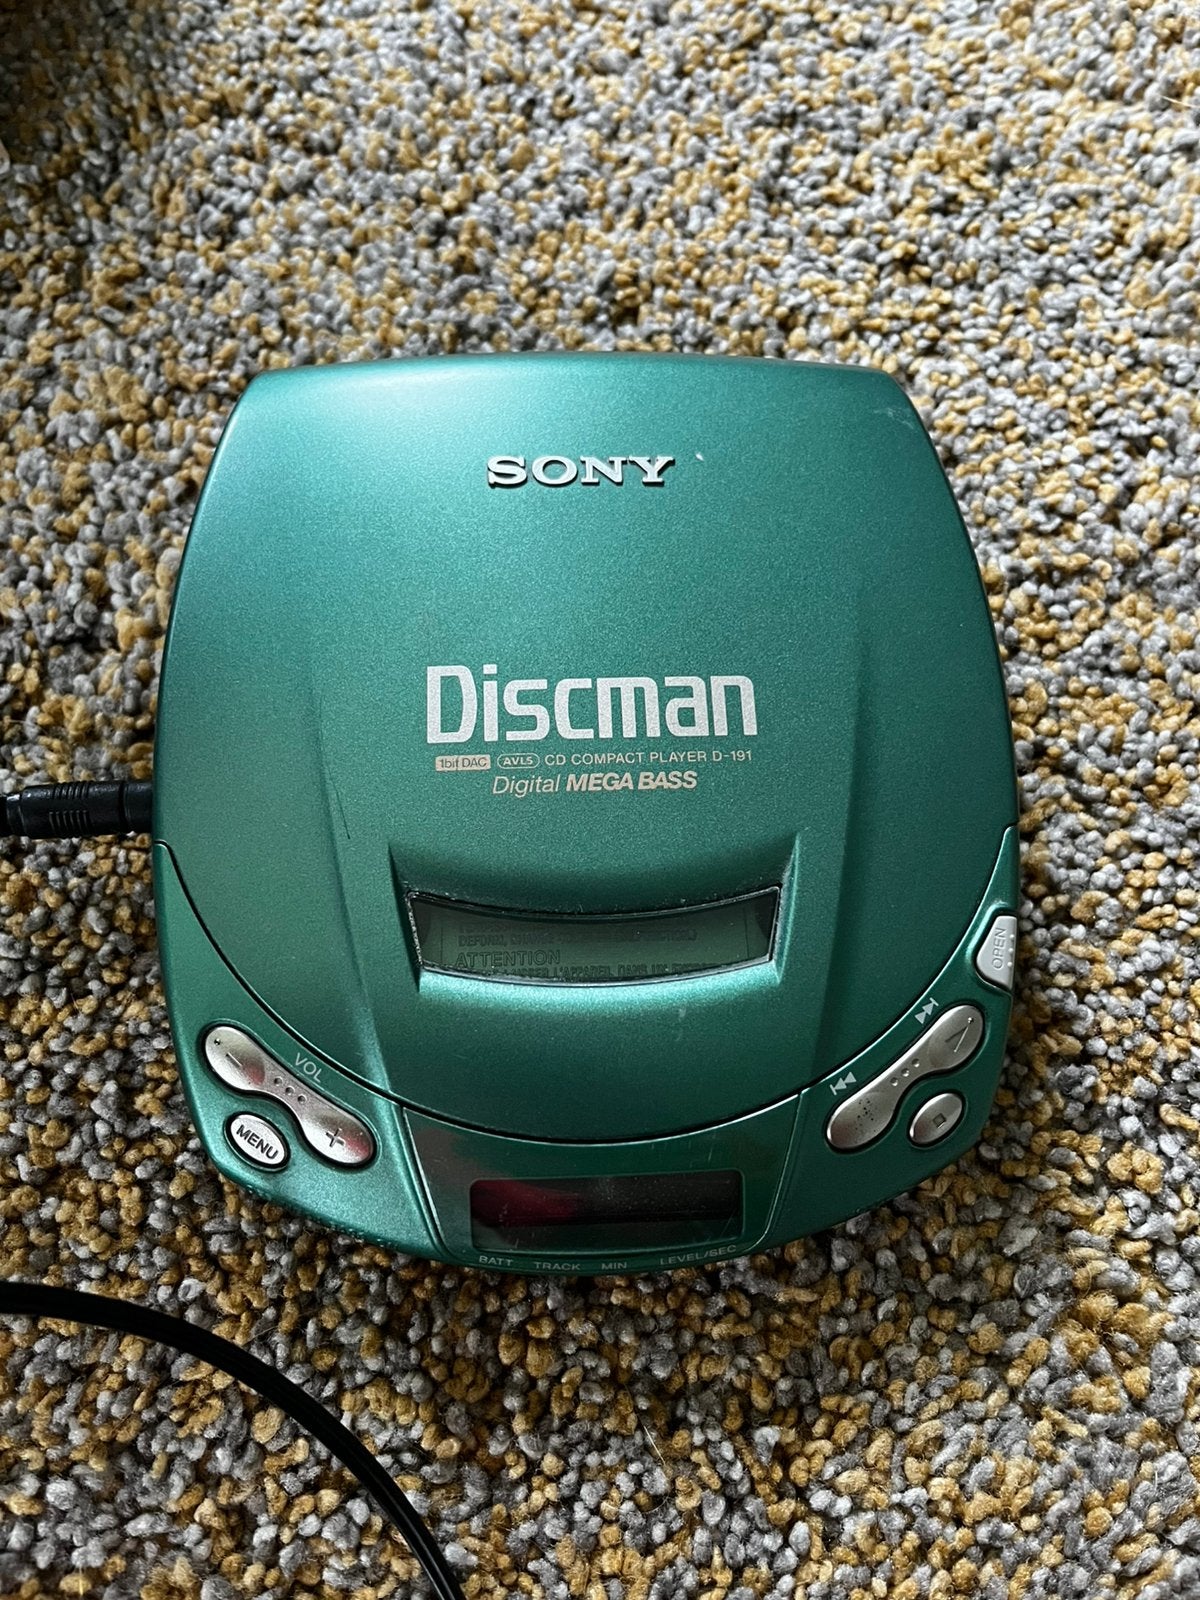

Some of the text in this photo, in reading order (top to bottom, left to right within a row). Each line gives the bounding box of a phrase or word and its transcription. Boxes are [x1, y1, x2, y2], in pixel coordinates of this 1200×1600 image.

[487, 455, 675, 489] SONY
[426, 664, 758, 744] Discman
[439, 750, 752, 769] 1bit DAC AVLS CD COMPACT PLAYER D-191
[492, 770, 698, 798] Digital MEGA BASS
[455, 949, 560, 967] ATTENTION
[991, 927, 1007, 970] OPEN
[294, 1052, 323, 1083] VOL
[236, 1124, 279, 1160] MENU
[479, 1255, 514, 1267] BATT
[534, 1261, 581, 1271] TRACK
[601, 1261, 628, 1270] MIN
[659, 1245, 737, 1266] LEVEL/SEC
